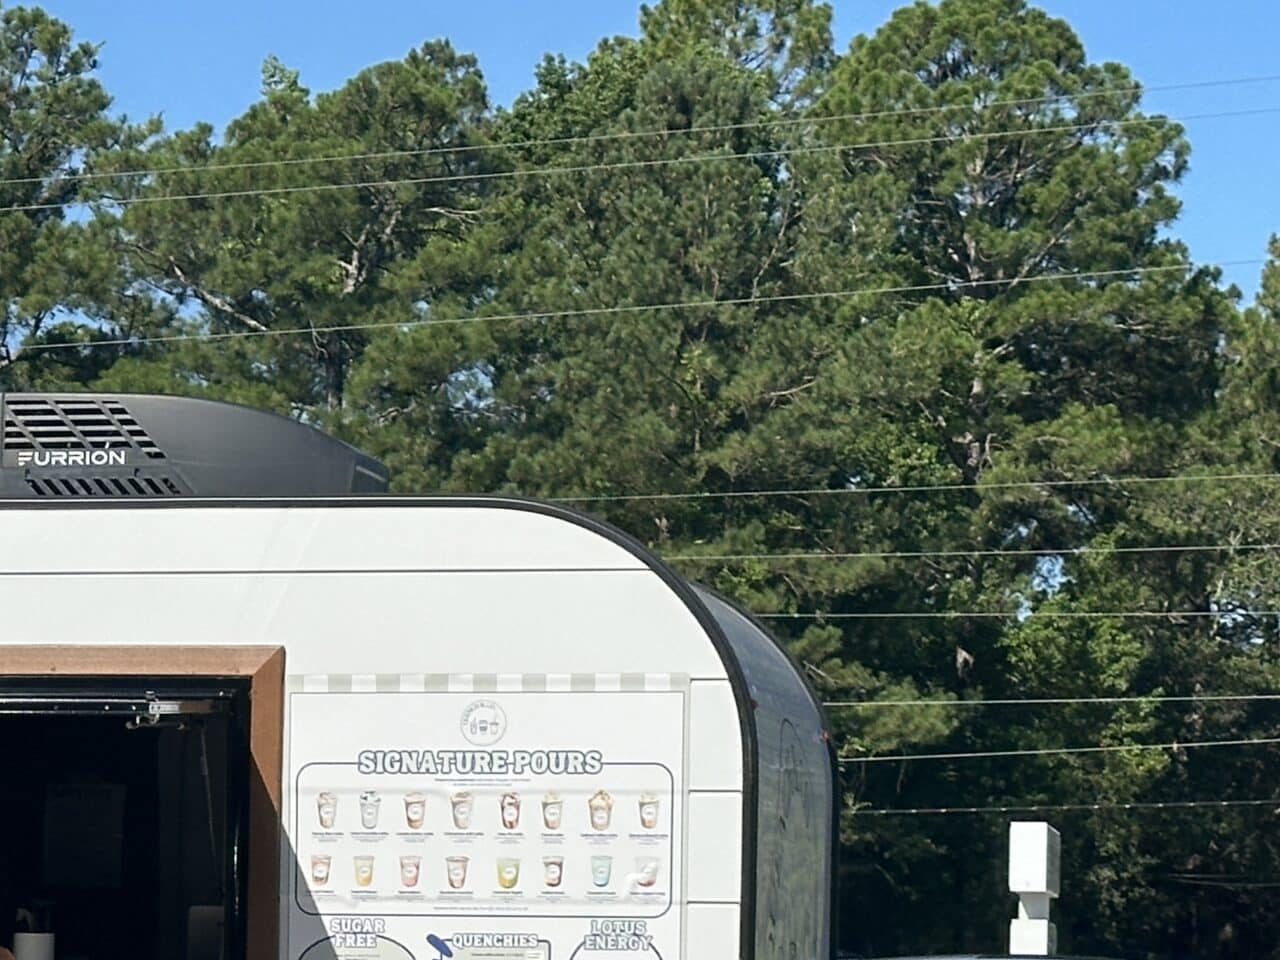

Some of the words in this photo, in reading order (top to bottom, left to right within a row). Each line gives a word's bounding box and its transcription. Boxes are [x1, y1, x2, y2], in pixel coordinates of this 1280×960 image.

[358, 749, 509, 775] SIGNATURE
[512, 750, 603, 775] POURS
[330, 917, 386, 934] SUGAR
[590, 919, 648, 937] LOTUS
[334, 932, 377, 948] FREE
[452, 933, 539, 949] QUENCHIES
[583, 934, 654, 951] ENERGY
